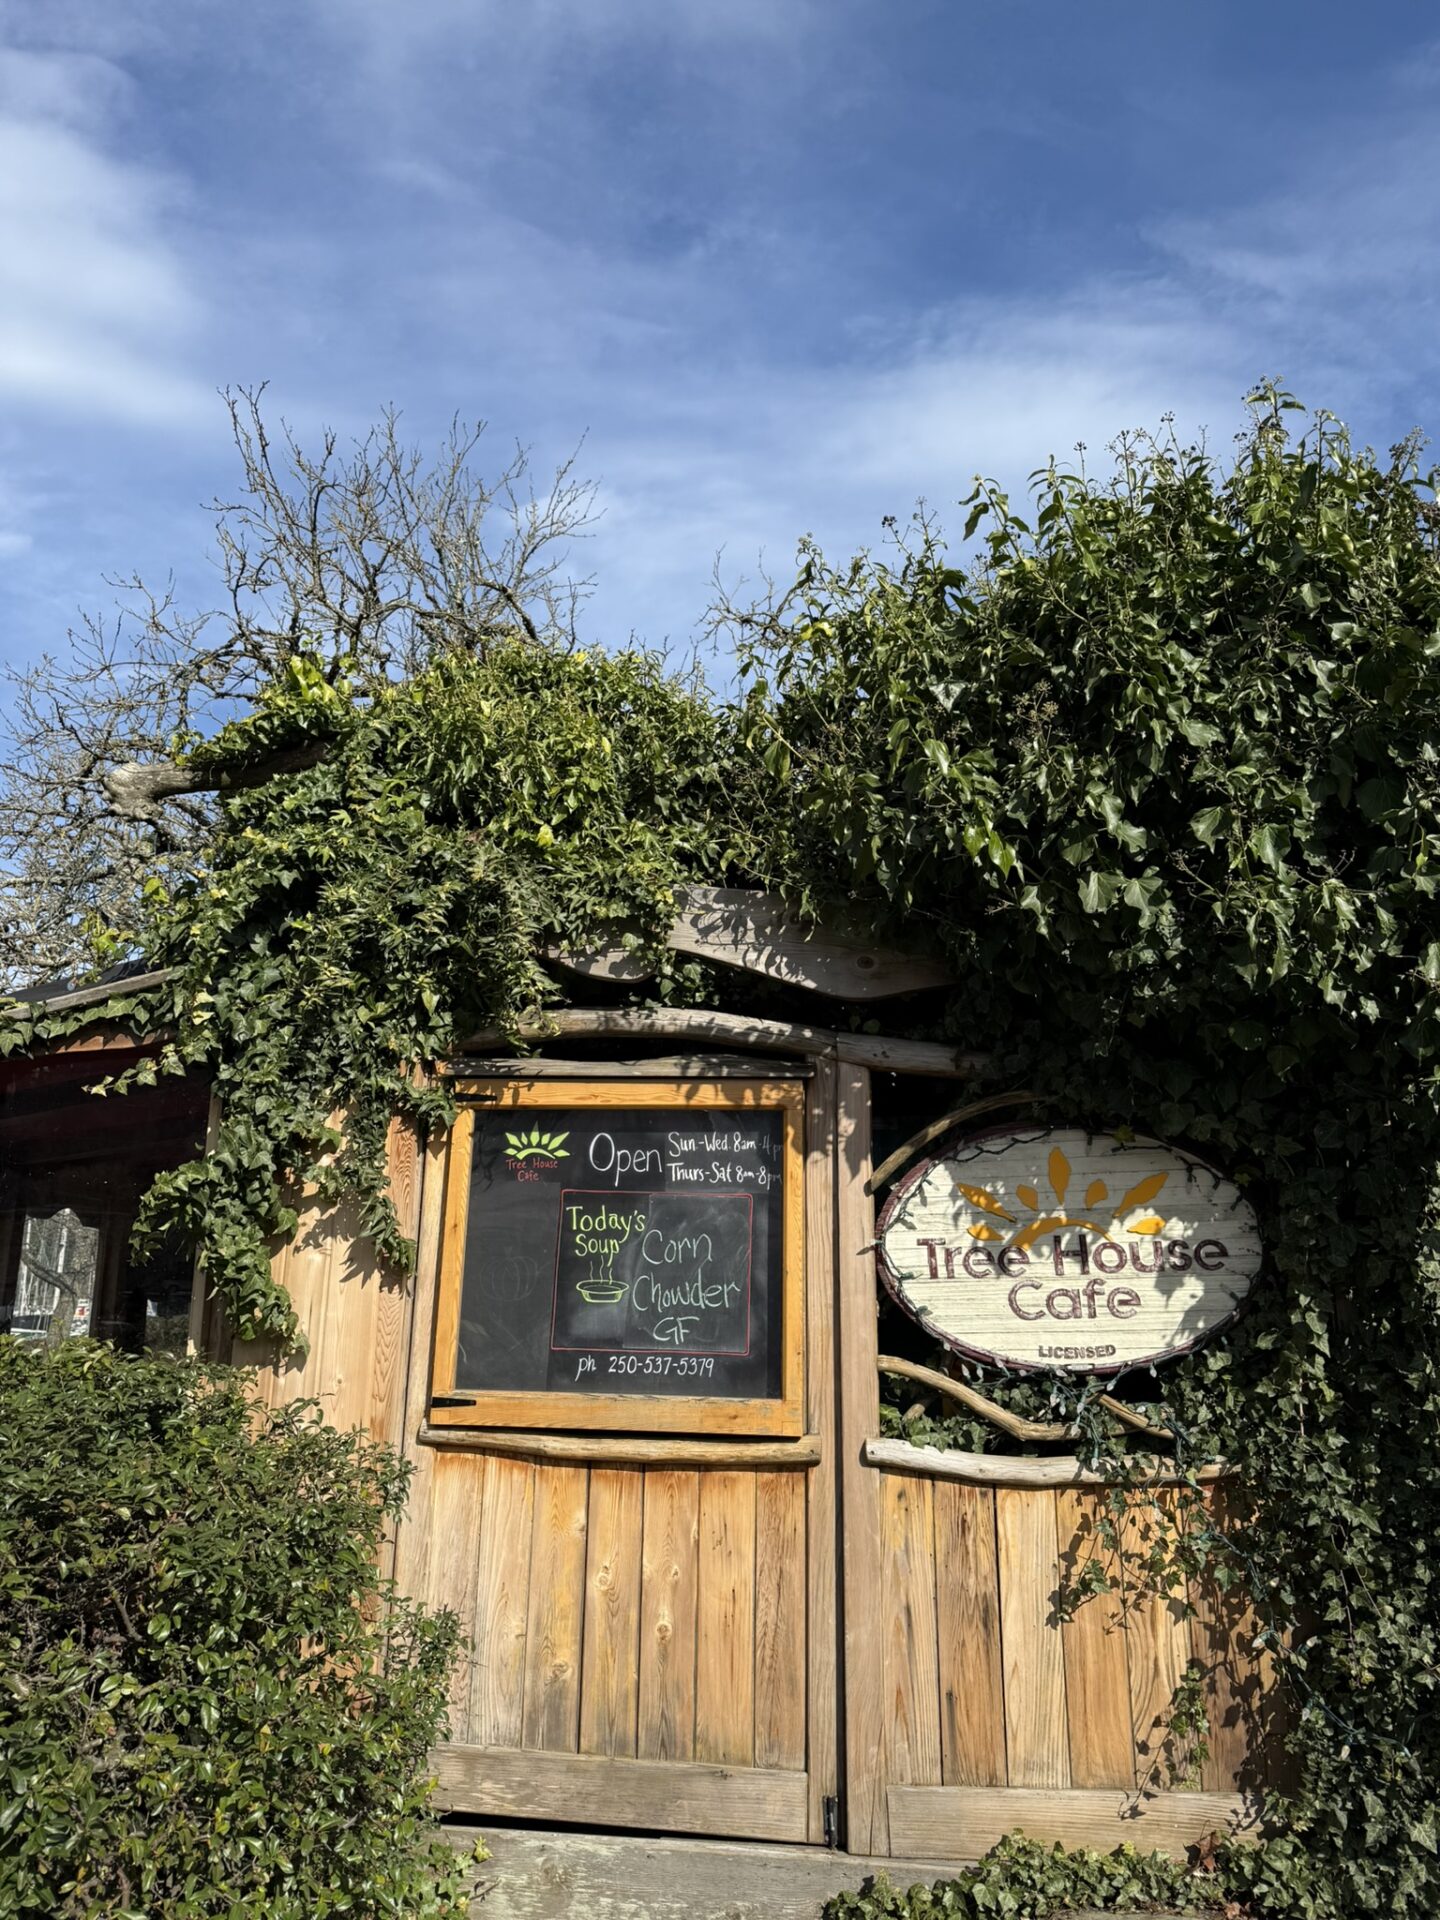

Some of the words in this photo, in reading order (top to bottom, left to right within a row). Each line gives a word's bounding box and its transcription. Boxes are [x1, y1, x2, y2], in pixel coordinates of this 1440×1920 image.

[505, 1158, 527, 1170] Tree
[533, 1157, 558, 1169] House
[517, 1169, 540, 1182] Cafe
[589, 1132, 663, 1187] Open
[566, 1205, 646, 1243] Today's
[575, 1233, 620, 1267] Soup
[642, 1229, 713, 1265] Corn
[916, 1237, 1030, 1280] Tree
[1053, 1234, 1229, 1276] House
[632, 1267, 741, 1313] Chowder
[1008, 1278, 1142, 1320] Cafe
[653, 1316, 700, 1345] GF
[575, 1354, 597, 1382] ph
[608, 1355, 715, 1378] 250-537-5379
[1038, 1344, 1117, 1359] LICENSED
